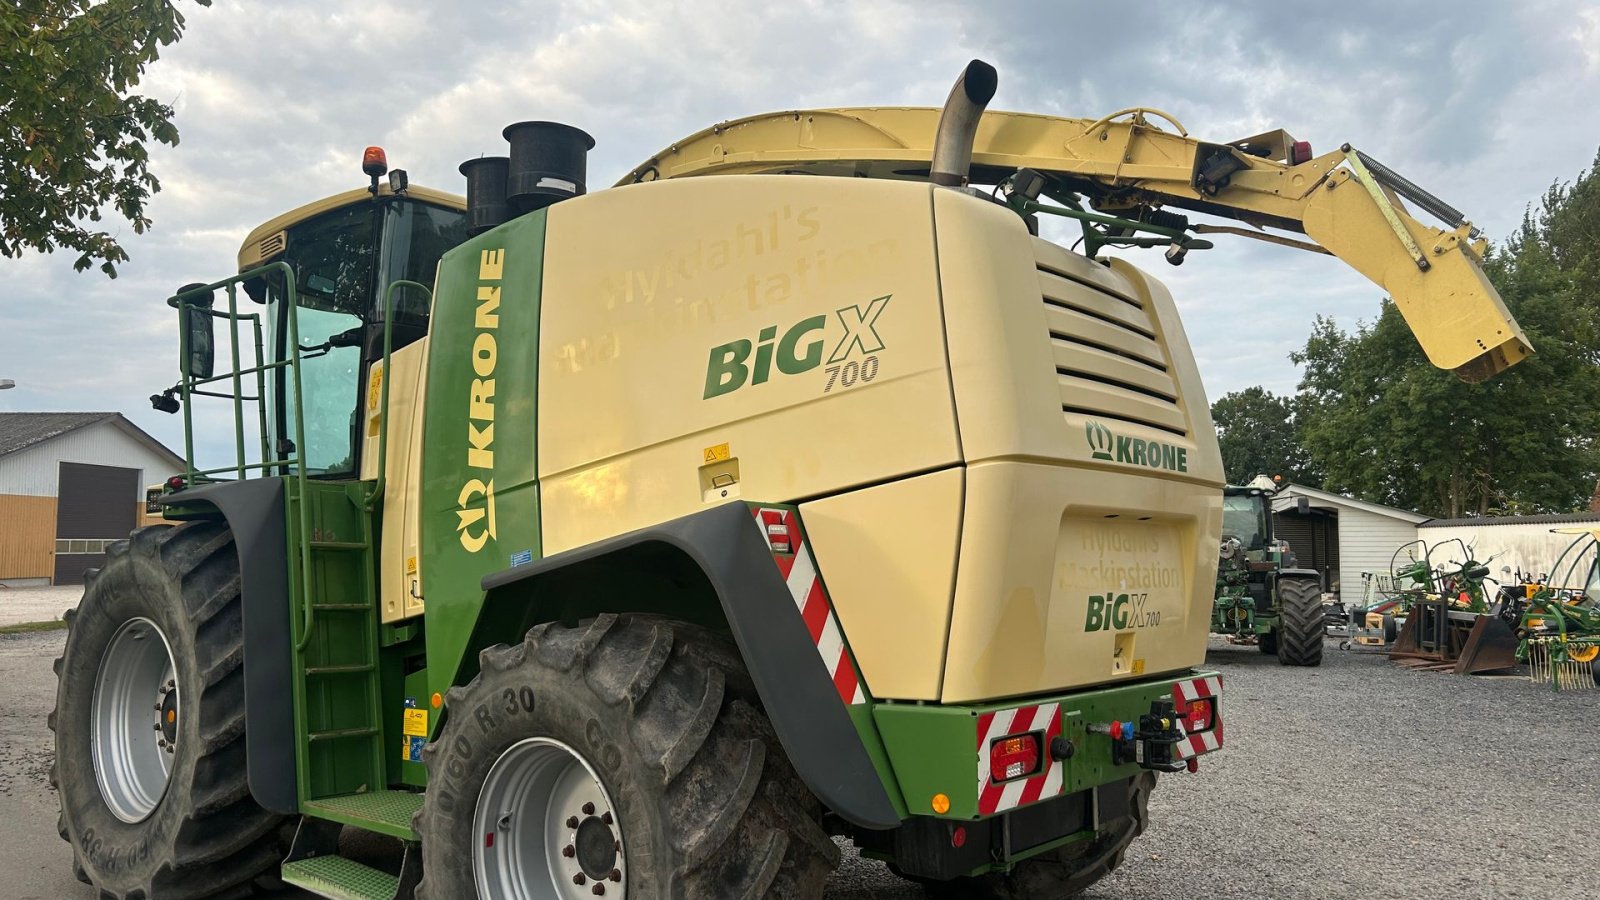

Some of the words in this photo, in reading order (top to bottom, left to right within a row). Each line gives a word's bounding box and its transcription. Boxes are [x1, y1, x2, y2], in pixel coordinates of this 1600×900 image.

[468, 248, 505, 470] KRONE
[824, 356, 880, 393] 700
[1116, 435, 1188, 473] KRONE
[1146, 611, 1161, 628] 700
[474, 703, 496, 734] R
[503, 685, 535, 716] 30
